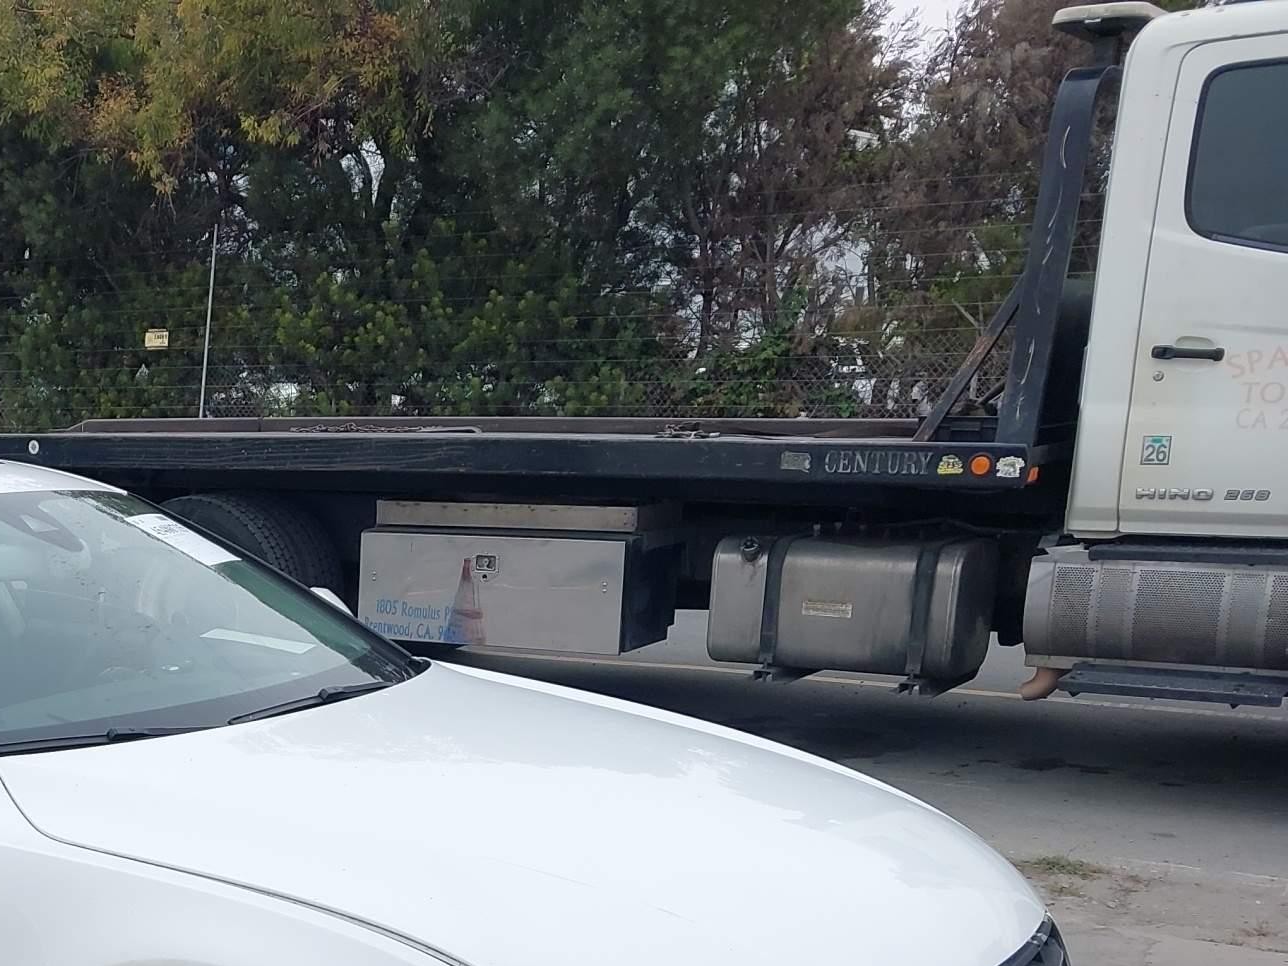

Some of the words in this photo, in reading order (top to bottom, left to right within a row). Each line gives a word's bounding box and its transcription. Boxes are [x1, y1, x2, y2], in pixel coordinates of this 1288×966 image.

[1236, 407, 1268, 430] CA
[824, 450, 934, 475] CENTURY
[1143, 444, 1167, 463] 26
[1135, 488, 1214, 501] HINO
[375, 599, 399, 616] 1805
[401, 600, 441, 621] Romulus
[416, 623, 434, 639] CA.
